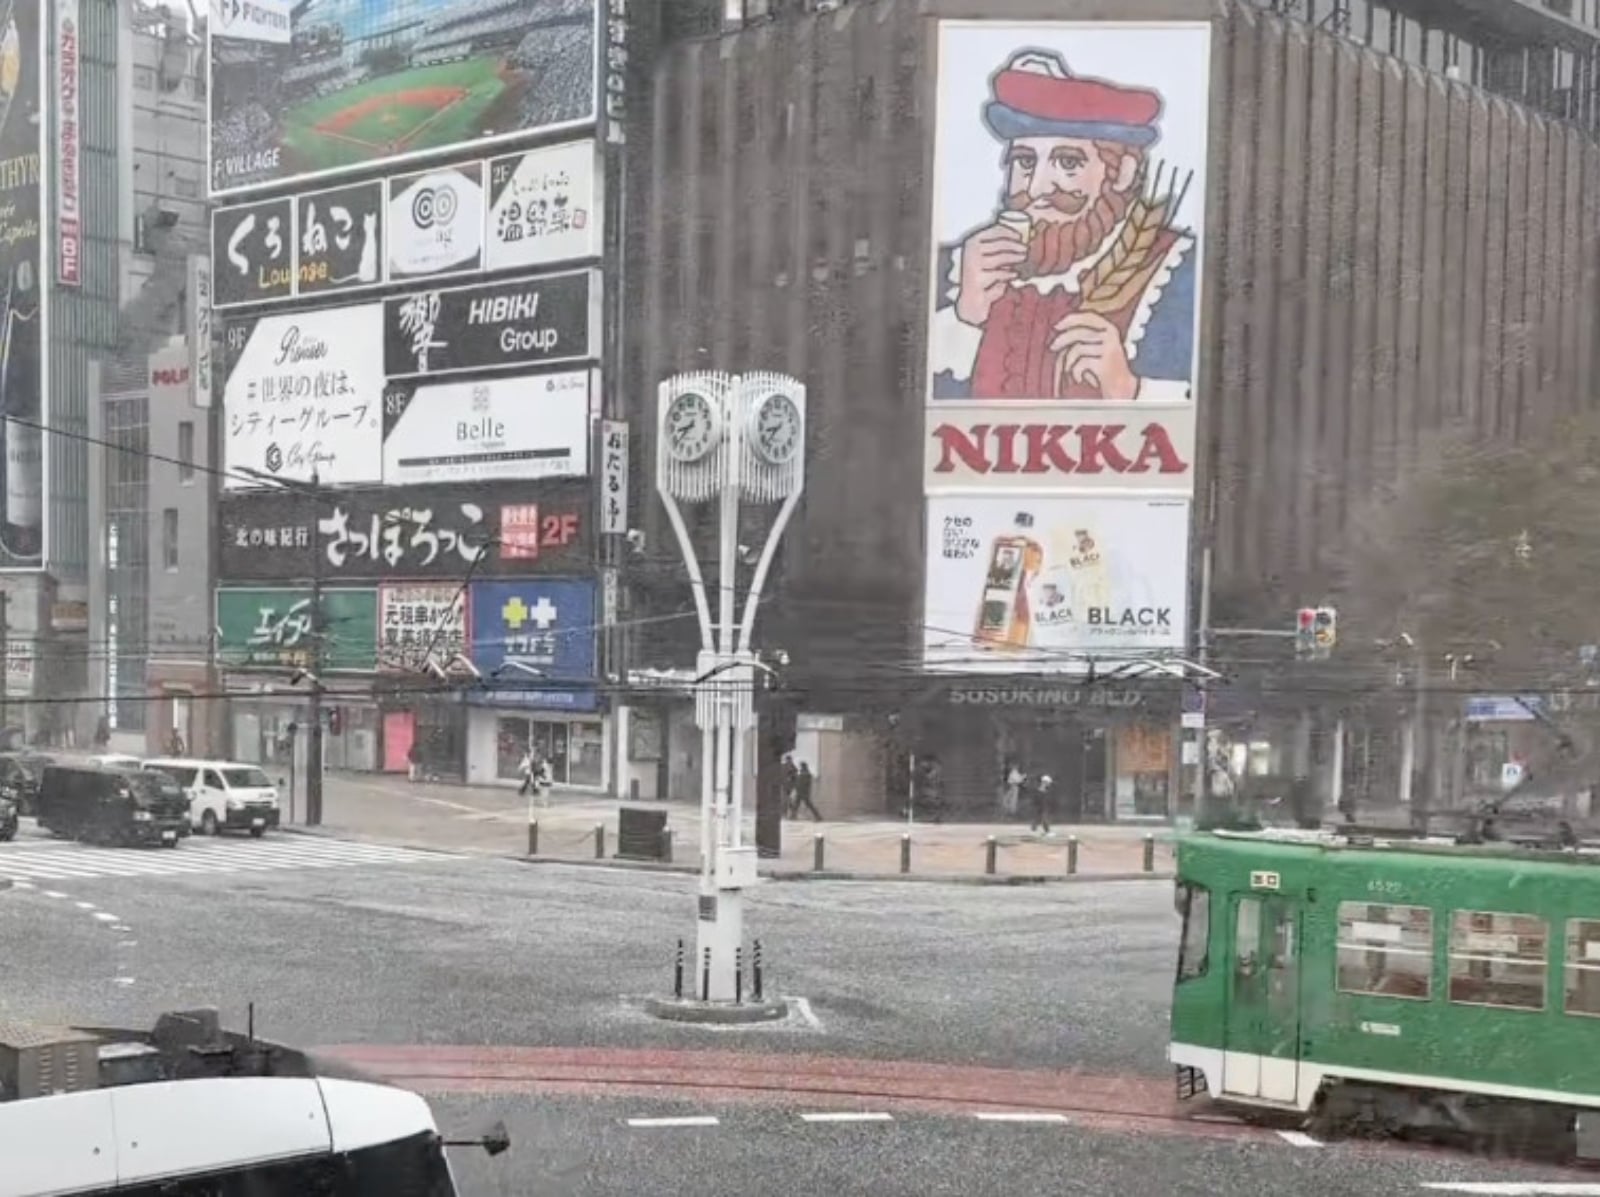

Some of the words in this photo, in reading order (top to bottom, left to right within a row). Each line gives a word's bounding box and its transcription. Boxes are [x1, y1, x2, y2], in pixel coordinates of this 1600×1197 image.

[226, 147, 281, 177] VILLAGE
[227, 201, 353, 275] くろねこ
[468, 292, 539, 325] HIBIKI
[501, 327, 558, 353] Group
[456, 418, 505, 440] Belle
[932, 423, 1188, 475] NIKKA
[318, 503, 486, 568] さっぽろっこ
[542, 515, 577, 545] 2F
[1087, 607, 1171, 627] BLACK
